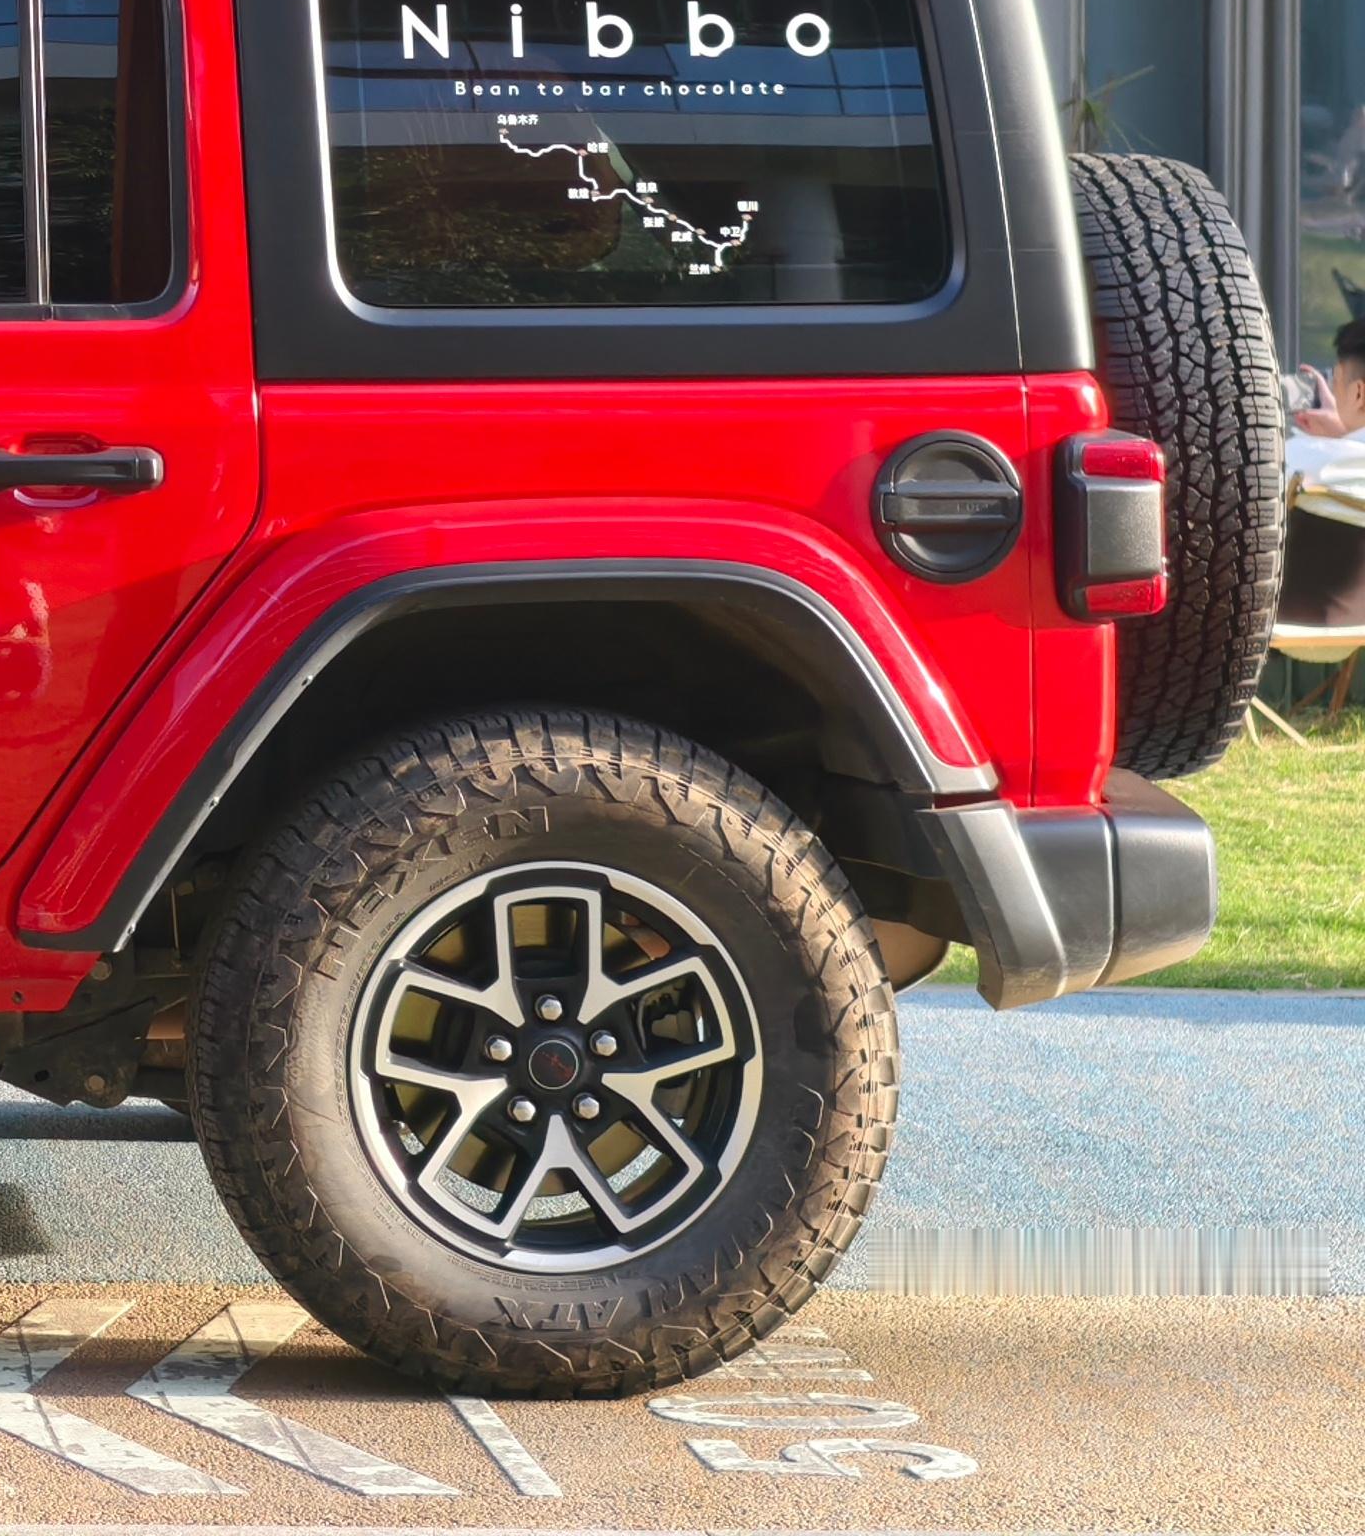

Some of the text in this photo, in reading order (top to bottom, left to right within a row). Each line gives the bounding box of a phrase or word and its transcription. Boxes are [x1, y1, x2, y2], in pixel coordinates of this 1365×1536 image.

[400, 0, 833, 60] Nibbo
[454, 80, 787, 97] Bean to bar chocolate
[497, 114, 539, 125] 乌鲁木齐
[720, 227, 741, 238] 中卫
